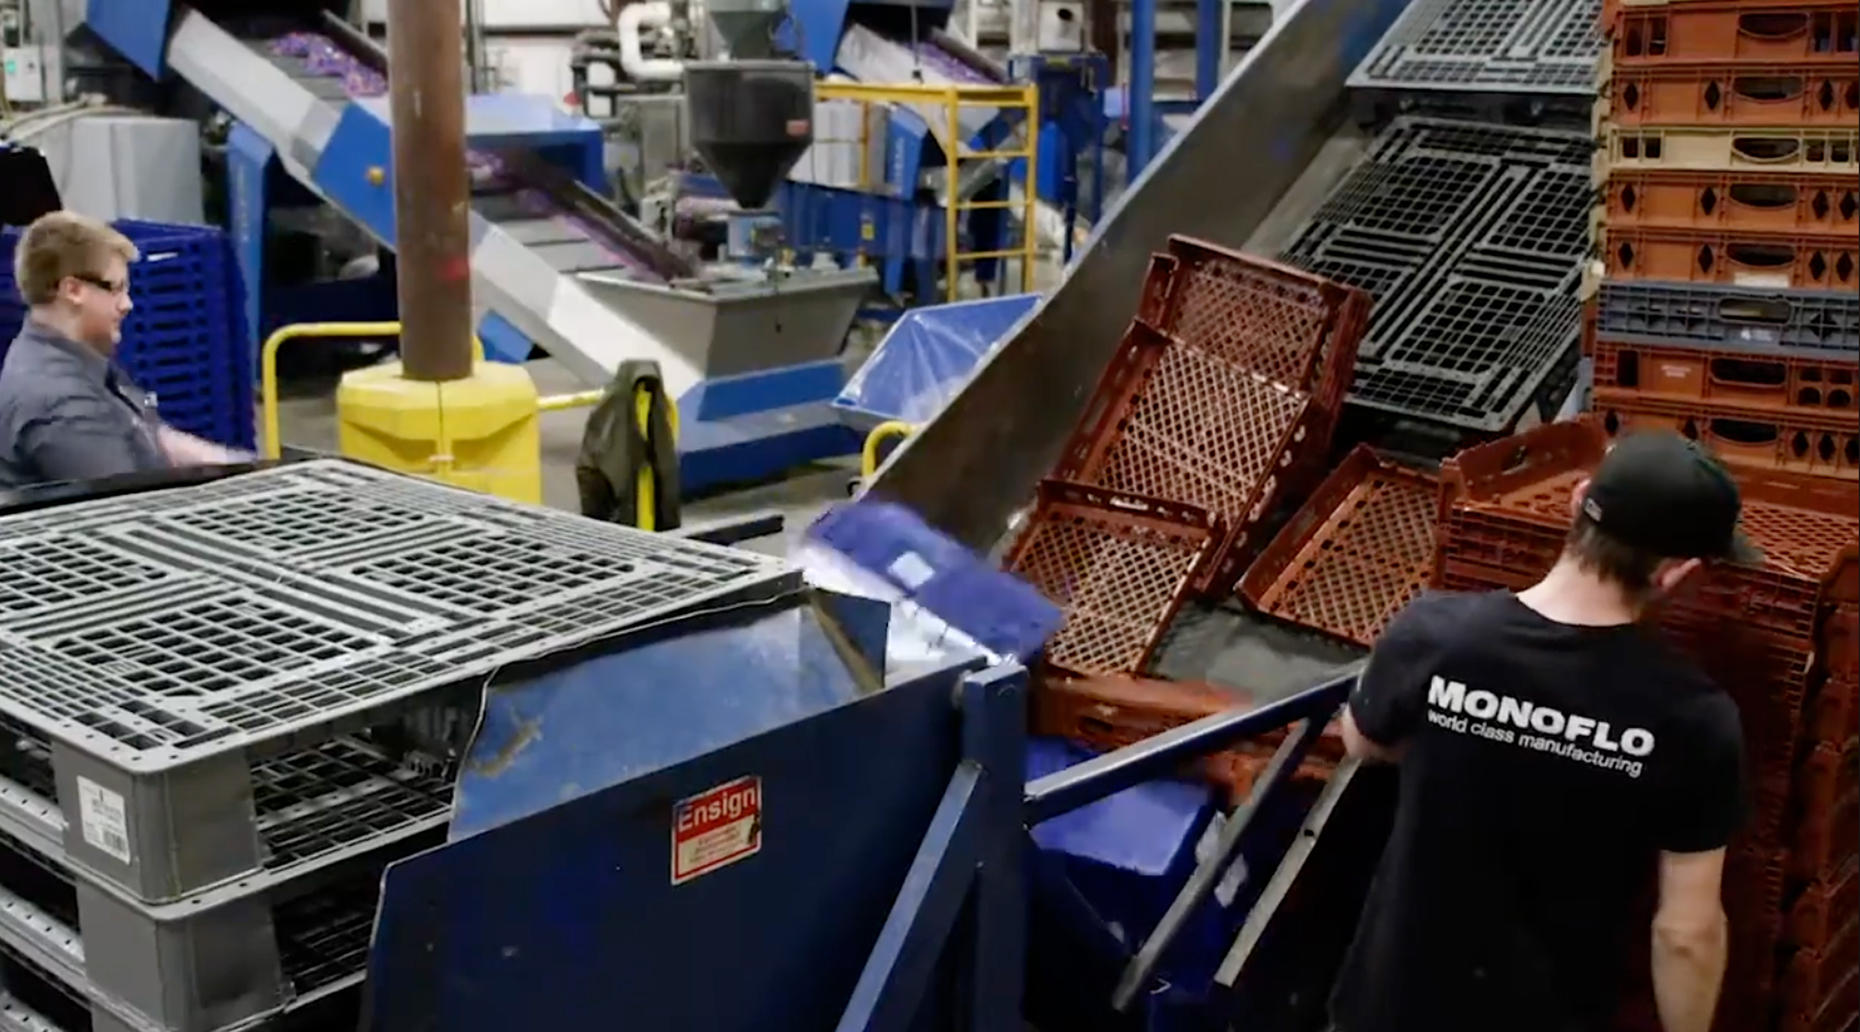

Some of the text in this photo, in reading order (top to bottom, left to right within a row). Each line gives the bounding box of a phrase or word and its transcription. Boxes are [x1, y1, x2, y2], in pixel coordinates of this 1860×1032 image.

[1428, 675, 1655, 756] MONOFLO
[1428, 709, 1643, 778] world class manufacturing
[678, 787, 755, 832] Ensign
